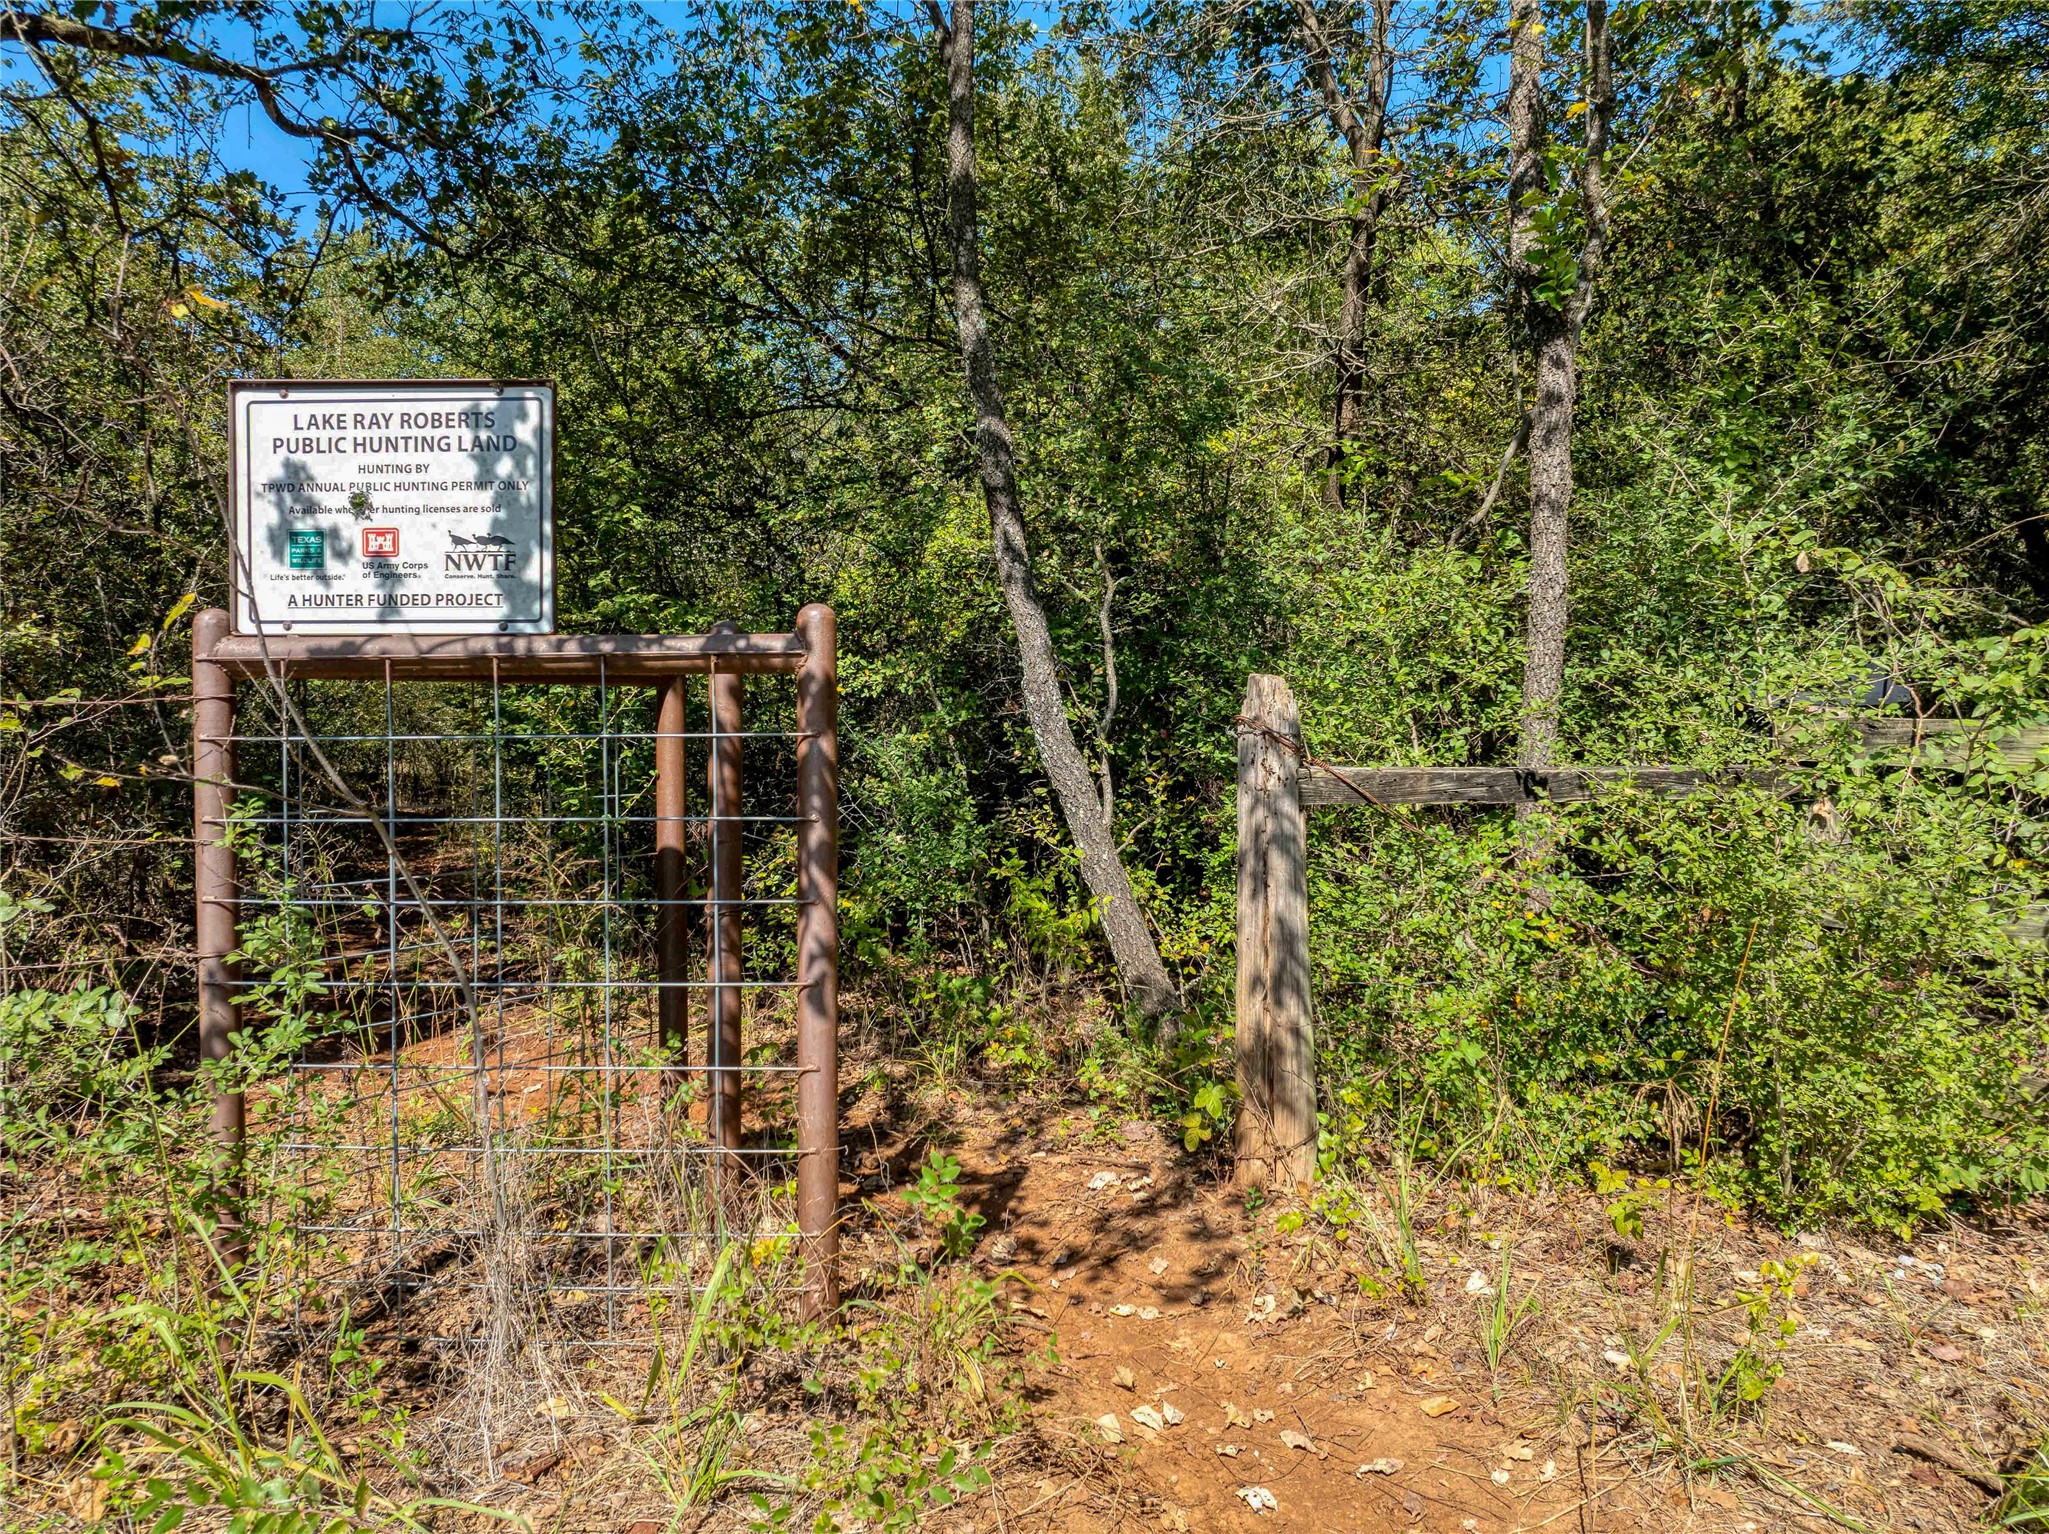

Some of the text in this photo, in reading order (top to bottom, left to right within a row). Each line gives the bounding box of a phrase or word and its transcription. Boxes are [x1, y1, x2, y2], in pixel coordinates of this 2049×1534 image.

[293, 412, 495, 430] LAKE RAY ROBERTS
[272, 435, 517, 454] PUBLIC HUNTING LAND
[358, 463, 430, 474] HUNTING BY
[261, 481, 529, 493] TPWD ANNUAL PUBLIC HUNTING PERMIT ONLY
[289, 506, 332, 514] Available
[335, 506, 379, 514] wheer
[382, 505, 420, 515] hunting
[422, 504, 460, 513] licenses
[481, 504, 501, 513] sold
[377, 562, 399, 571] Army
[402, 562, 428, 570] Corps
[445, 554, 516, 571] NWTF
[288, 594, 503, 606] A HUNTER FUNDED PROJECT
